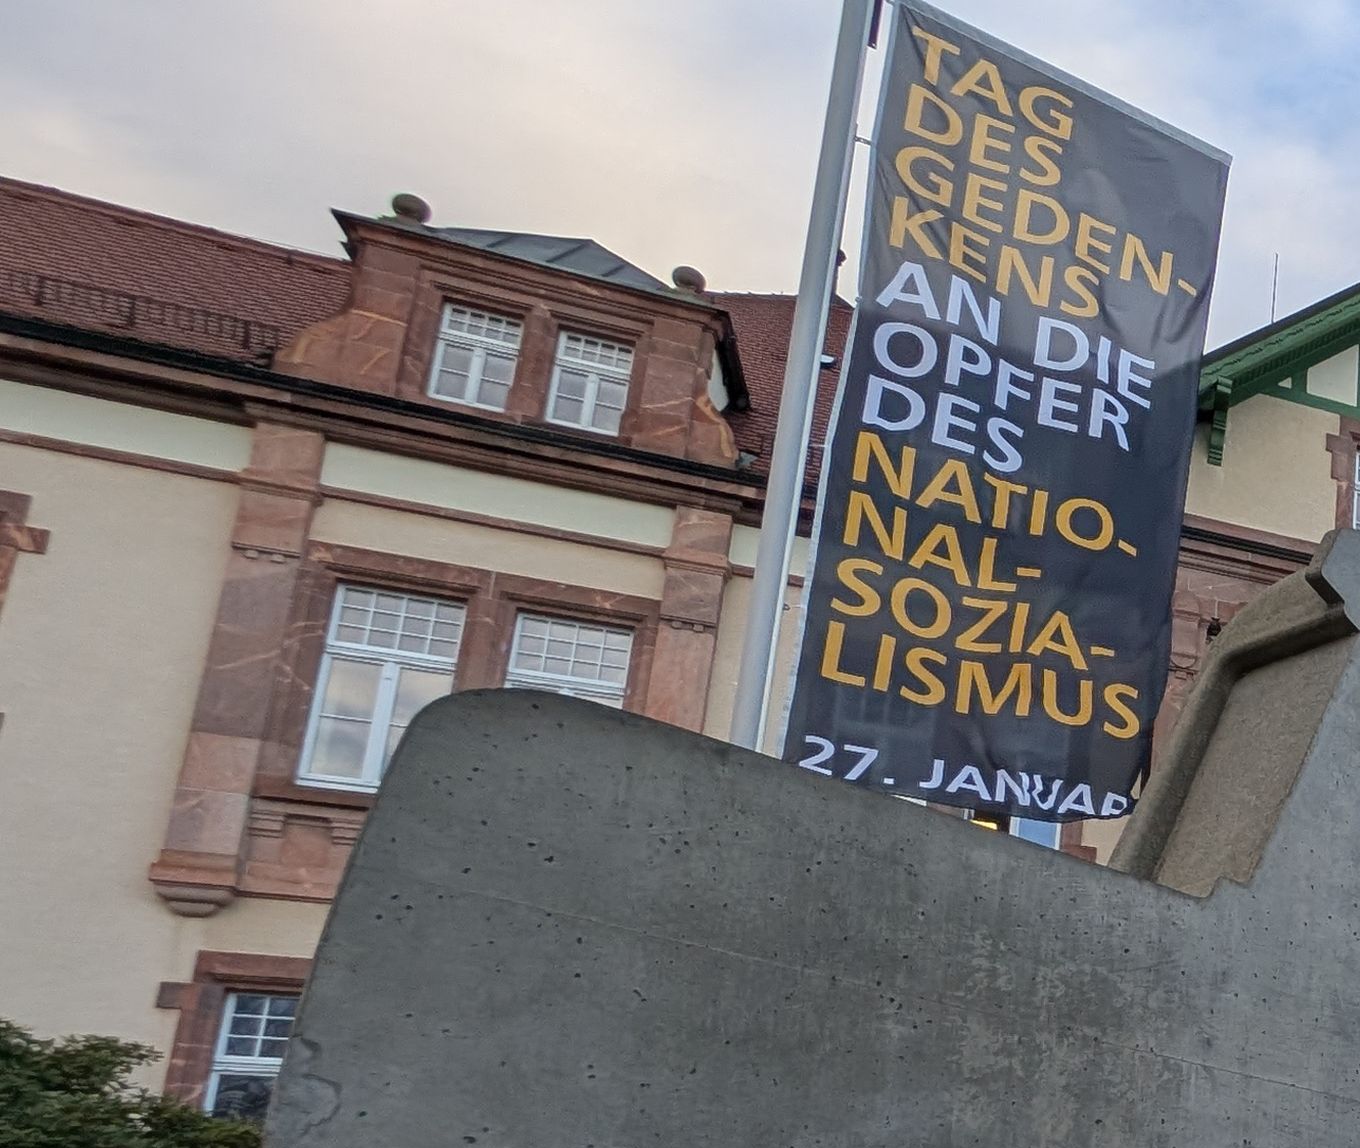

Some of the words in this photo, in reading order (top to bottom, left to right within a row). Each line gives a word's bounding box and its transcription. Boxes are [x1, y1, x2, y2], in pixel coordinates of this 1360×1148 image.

[904, 83, 1063, 186] DES
[911, 25, 1074, 140] TAG
[889, 196, 1100, 318] KENS
[895, 146, 1198, 297] GEDEN-
[873, 322, 1130, 451] OPFER
[875, 261, 1001, 346] AN
[1033, 316, 1156, 409] DIE
[861, 374, 1024, 473] DES
[843, 490, 1042, 593] NAL-
[852, 430, 1138, 558] NATIO-
[830, 558, 1116, 670] SOZIA-
[821, 620, 1141, 740] LISMUS
[798, 735, 896, 786] 27.
